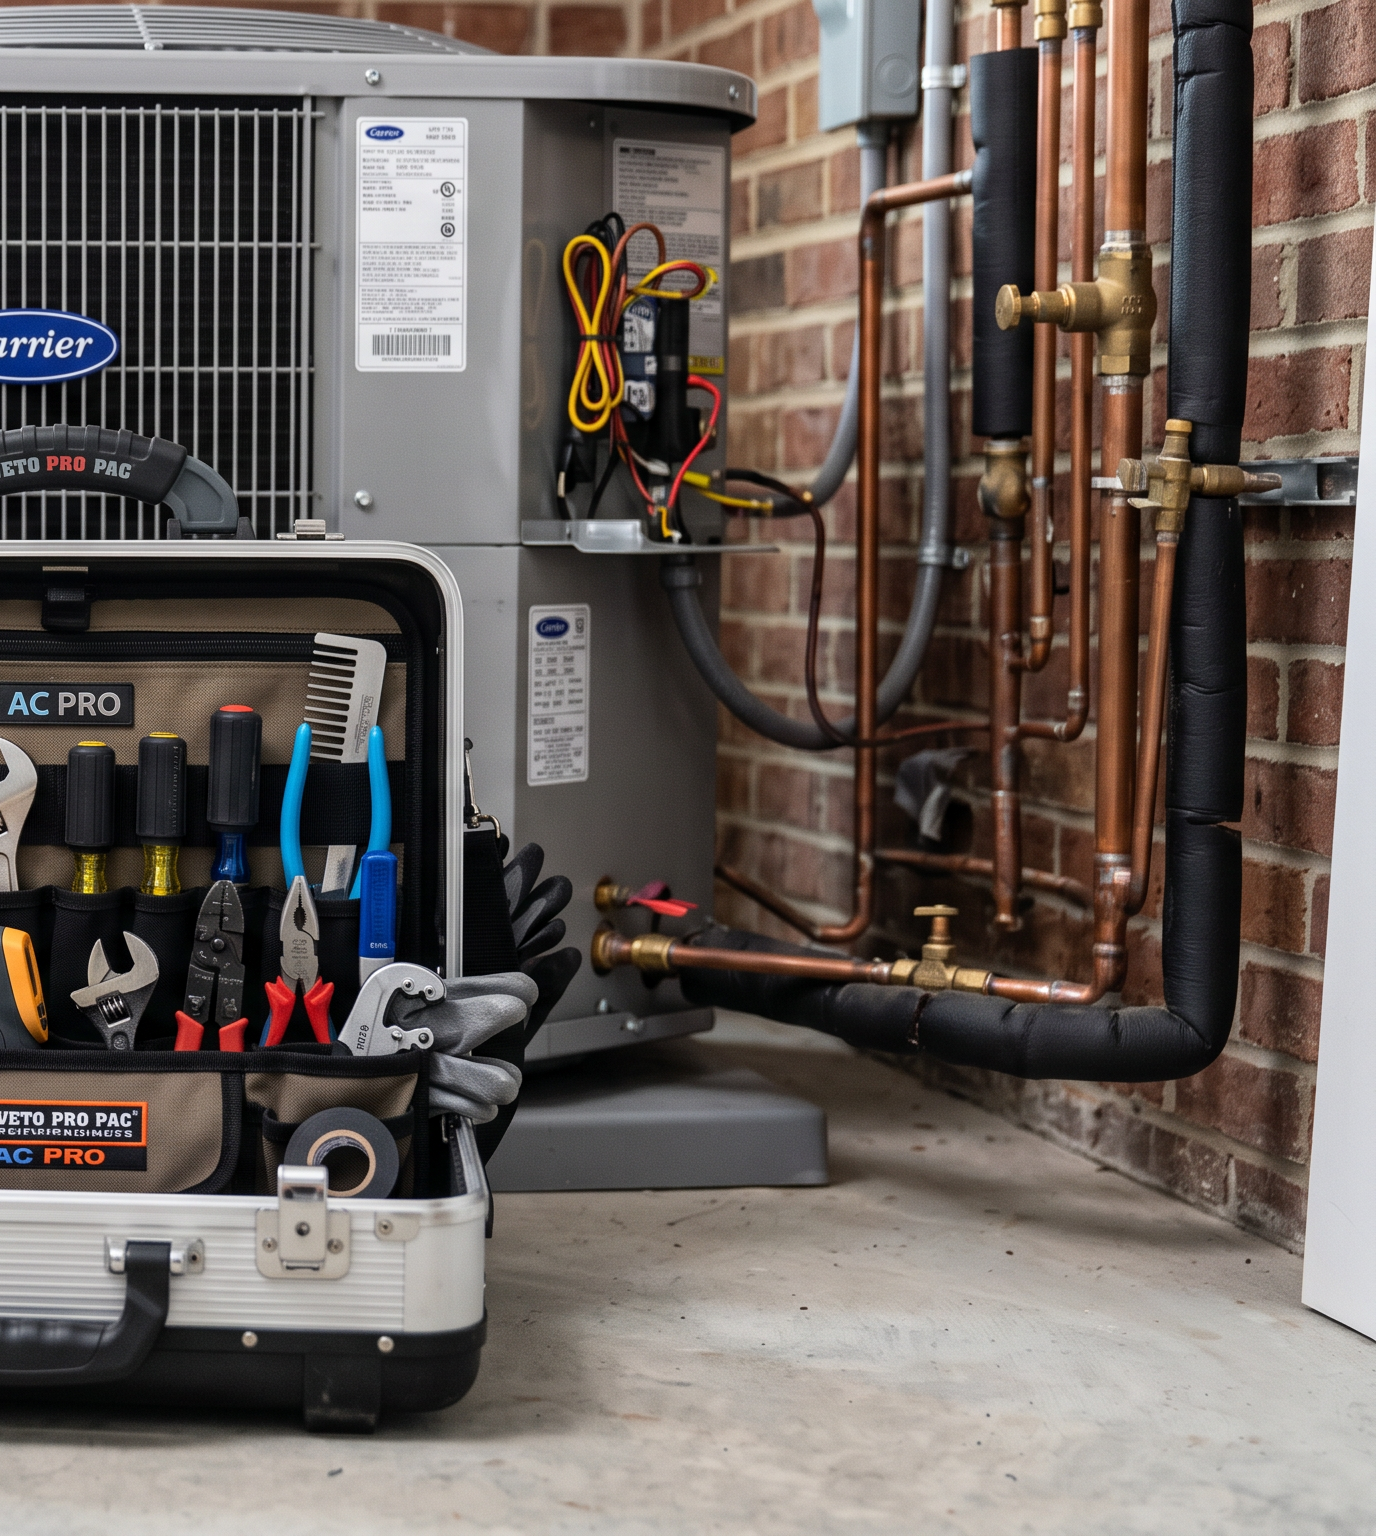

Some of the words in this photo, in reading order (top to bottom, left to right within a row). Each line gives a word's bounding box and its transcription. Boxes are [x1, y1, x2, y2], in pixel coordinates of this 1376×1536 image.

[46, 455, 86, 473] PRO
[93, 458, 132, 480] PAC
[7, 691, 50, 716] AC
[58, 692, 121, 717] PRO
[51, 1111, 89, 1127] PRO
[95, 1112, 132, 1128] PAC
[43, 1147, 106, 1166] PRO
